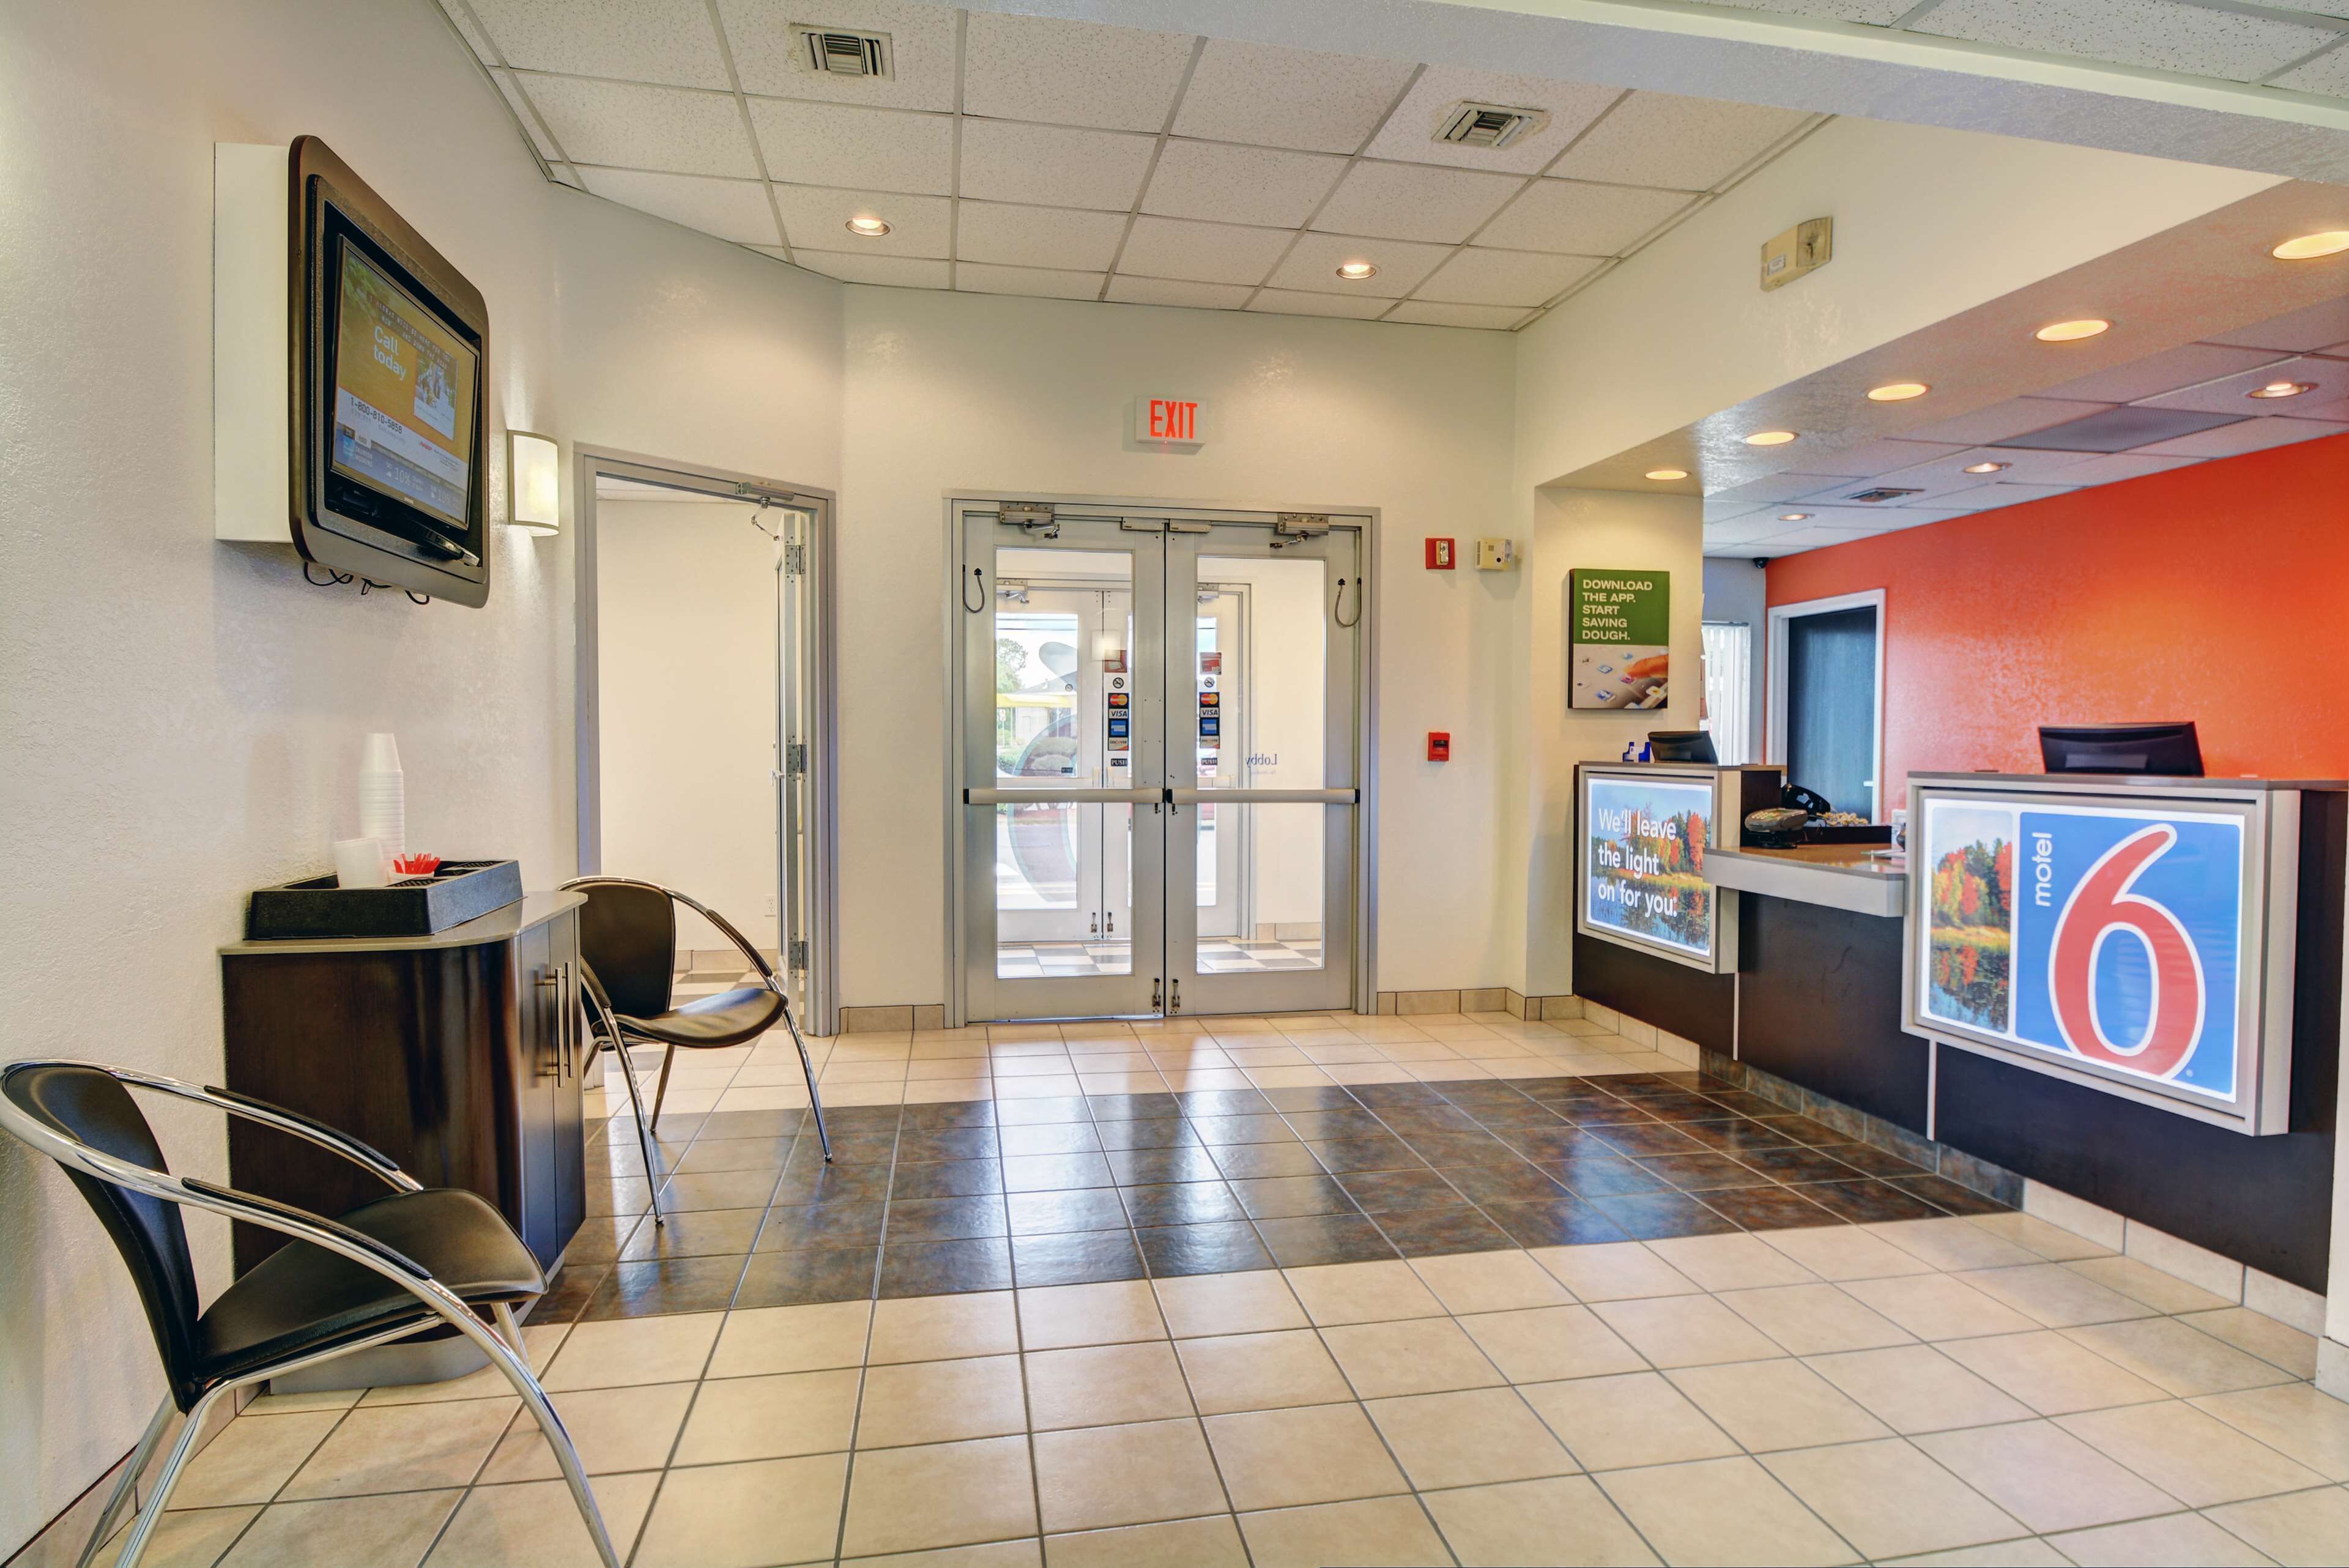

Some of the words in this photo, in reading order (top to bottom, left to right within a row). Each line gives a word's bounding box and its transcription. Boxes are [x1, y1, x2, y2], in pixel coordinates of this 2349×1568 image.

[374, 325, 399, 355] Call
[374, 344, 406, 382] today
[1150, 399, 1198, 439] EXIT
[1582, 592, 1607, 602] THE
[1610, 593, 1636, 603] APP.
[1583, 579, 1653, 590] DOWNLOAD
[1582, 604, 1620, 615] START
[1582, 617, 1627, 628] SAVING
[1582, 630, 1630, 641] DOUGH.
[1598, 808, 1631, 835] We'll
[1637, 810, 1677, 841] leave
[1598, 842, 1621, 868] the
[1625, 845, 1660, 880] light
[1598, 883, 1615, 902] on
[1619, 879, 1641, 908] for
[2032, 832, 2053, 907] motel
[2048, 823, 2206, 1080] 6
